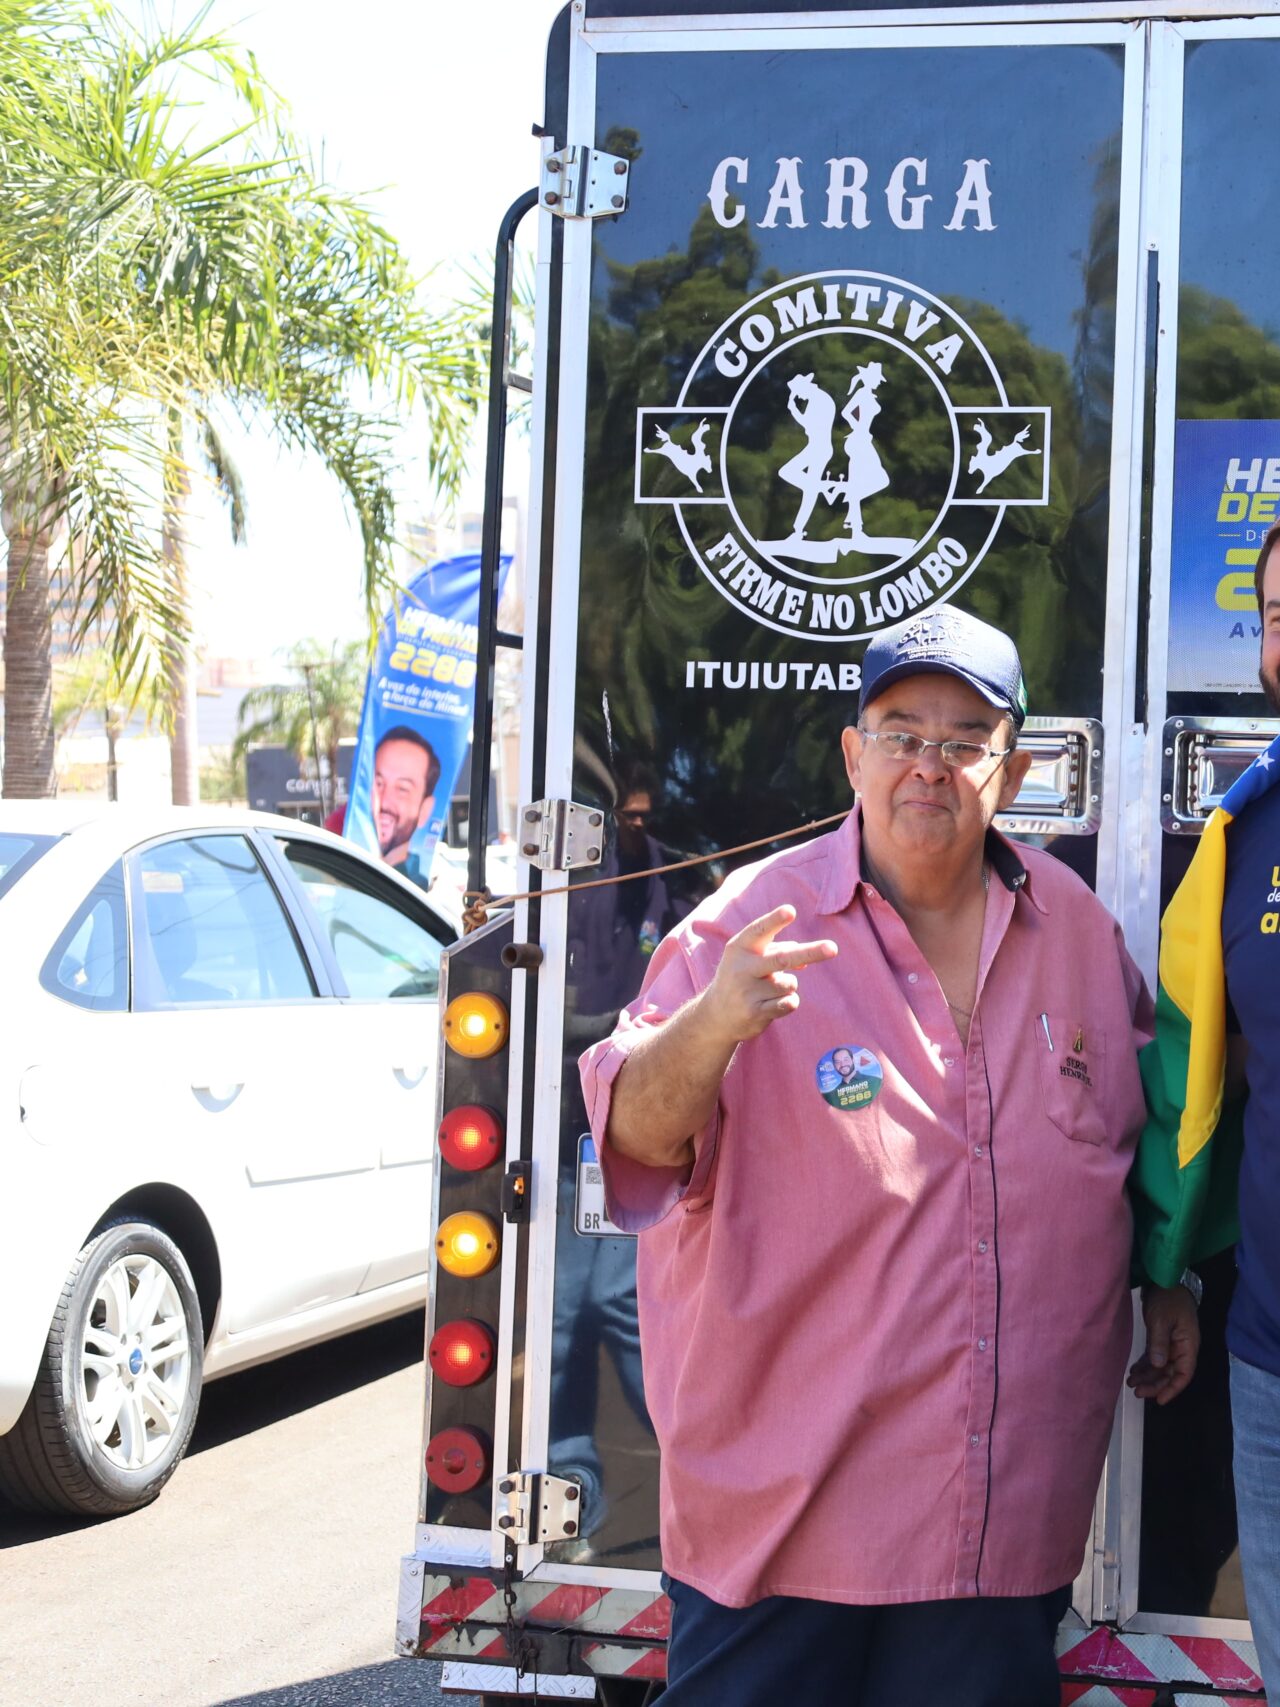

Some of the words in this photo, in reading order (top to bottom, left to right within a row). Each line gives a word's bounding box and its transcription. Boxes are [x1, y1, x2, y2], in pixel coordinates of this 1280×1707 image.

[706, 156, 998, 231] CARGA
[714, 283, 964, 377] COMITIVA
[704, 532, 807, 625] FIRME
[809, 593, 856, 630] NO
[859, 537, 968, 626] LOMBO
[1229, 622, 1244, 638] A
[389, 641, 477, 689] 2288
[685, 660, 862, 691] ITUIUTAB
[840, 1091, 872, 1106] 2288
[584, 1213, 600, 1230] BR
